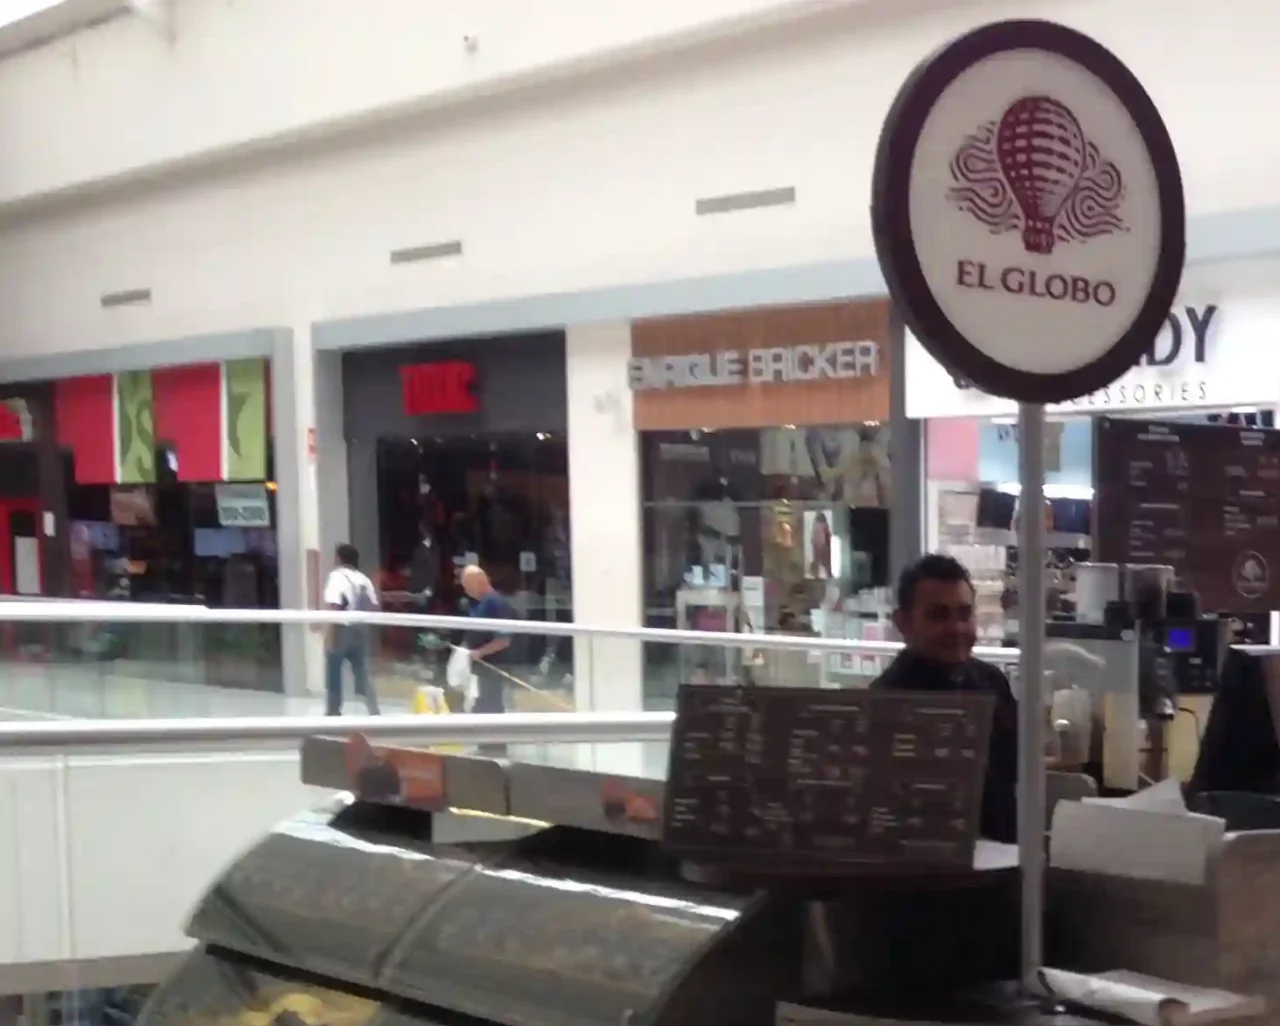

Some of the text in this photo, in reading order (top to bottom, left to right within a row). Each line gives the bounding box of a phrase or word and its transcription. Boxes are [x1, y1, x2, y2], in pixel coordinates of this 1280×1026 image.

[957, 259, 1116, 308] EL GLOBO
[747, 339, 880, 384] BRICKER
